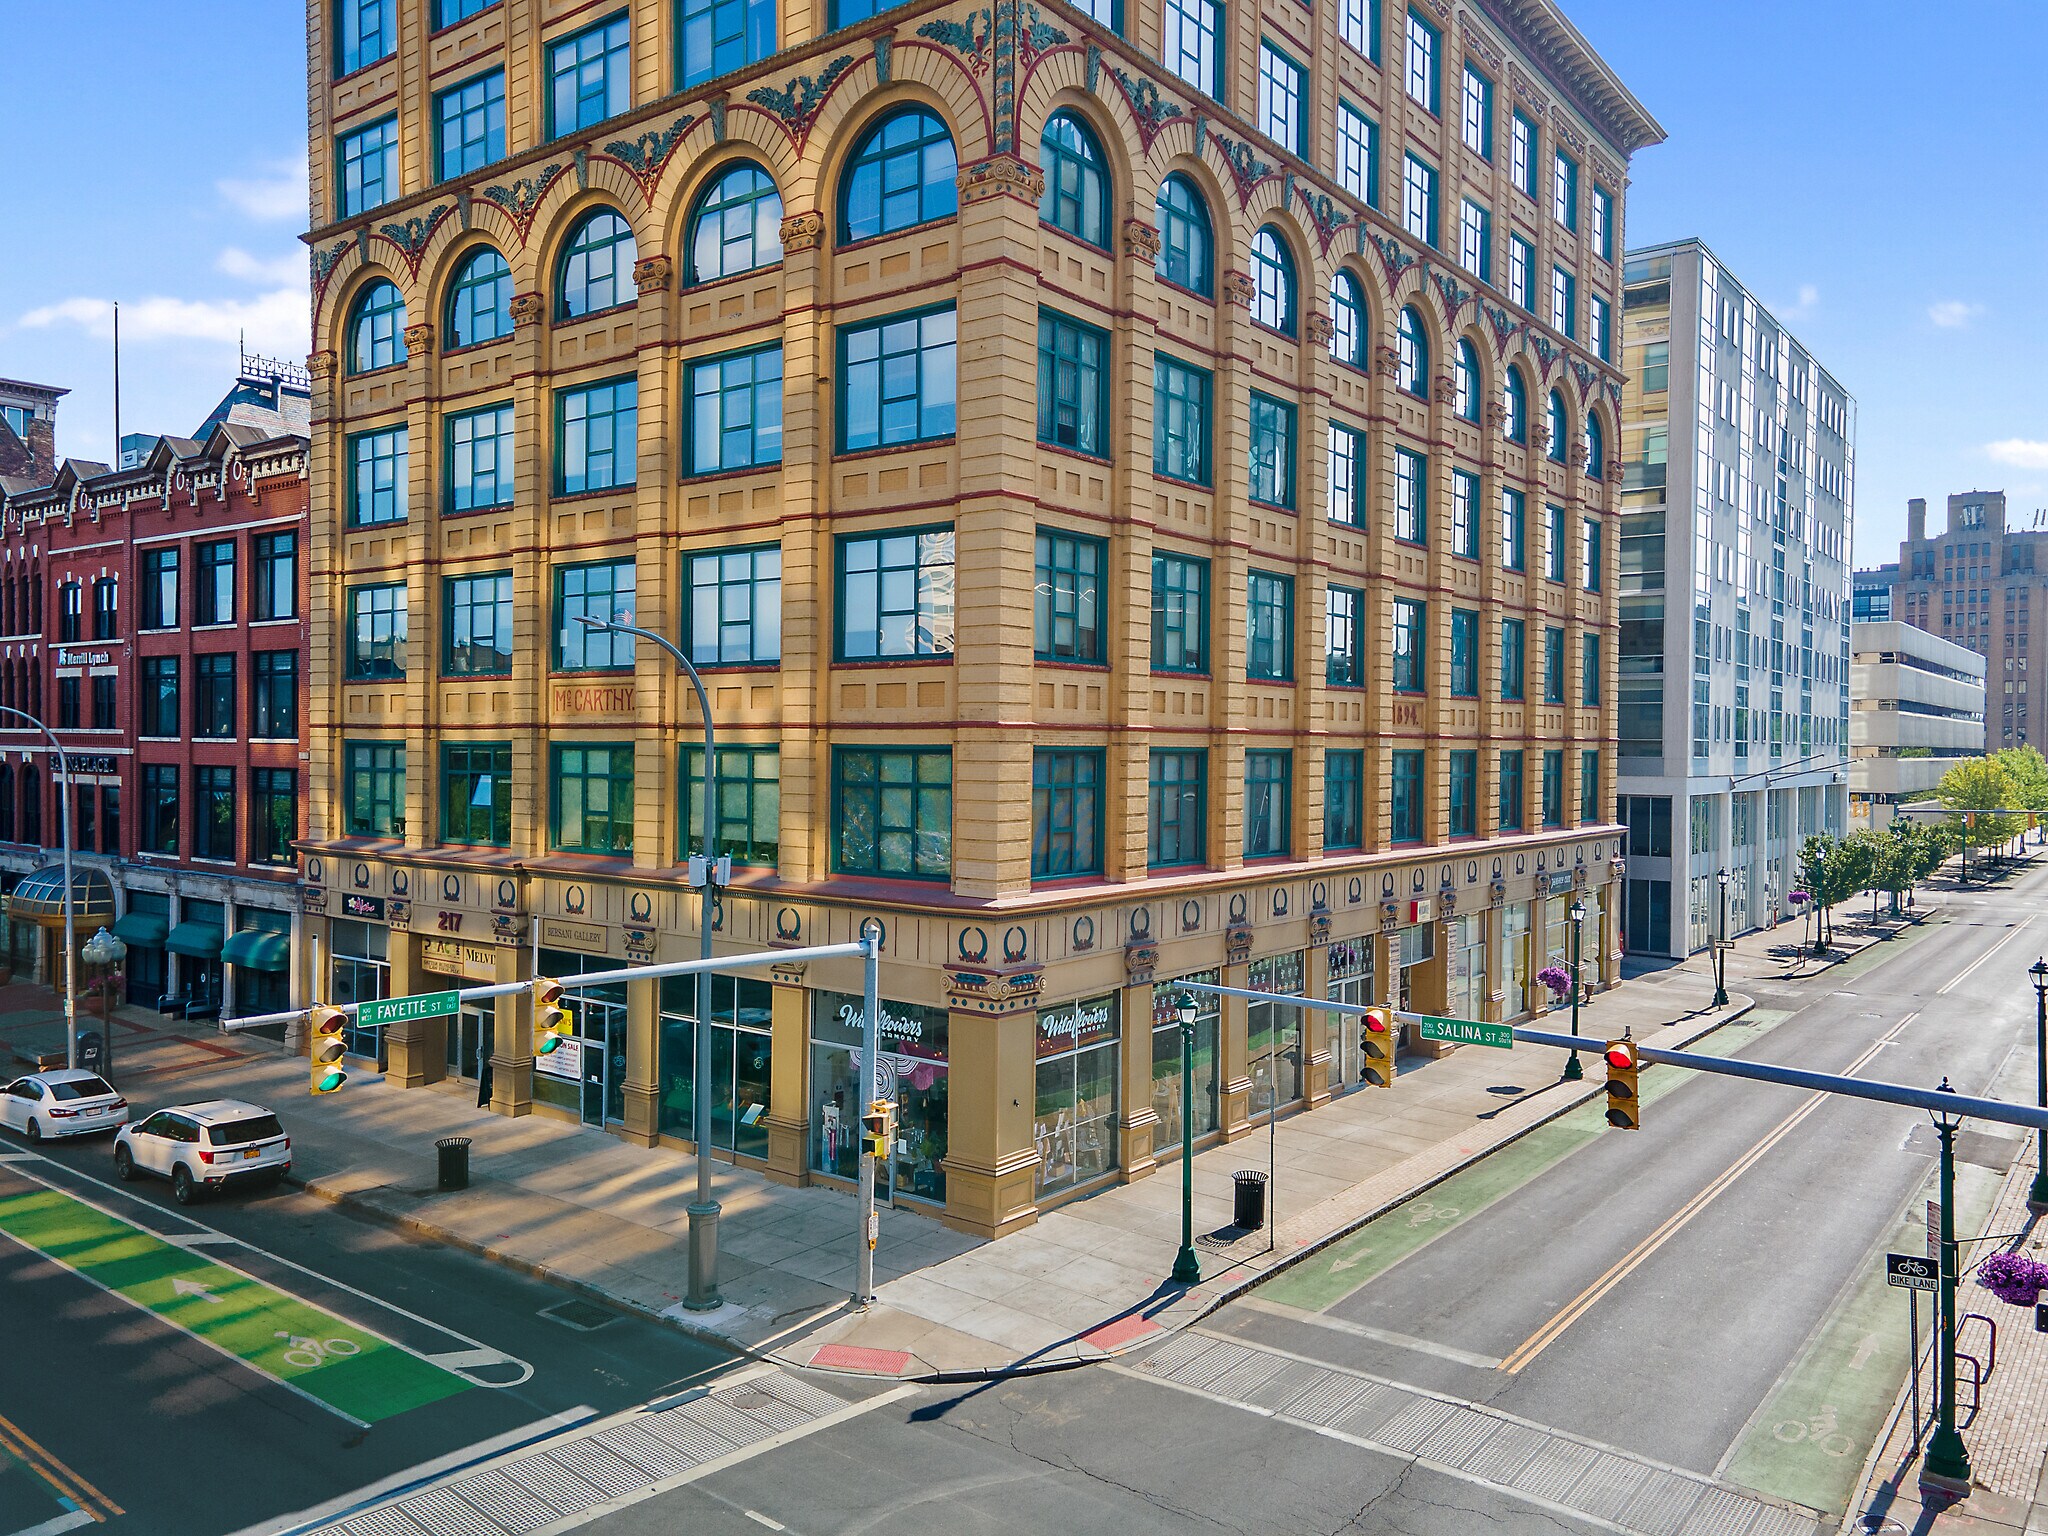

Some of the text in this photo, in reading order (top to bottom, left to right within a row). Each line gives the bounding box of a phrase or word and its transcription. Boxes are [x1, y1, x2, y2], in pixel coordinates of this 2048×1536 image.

[89, 651, 109, 666] Lynch
[50, 756, 79, 771] SANA
[437, 910, 463, 932] 217
[574, 930, 601, 943] GALLERY
[377, 1000, 441, 1019] FAYETTE ST
[840, 1004, 922, 1037] Wilowers
[1042, 1006, 1108, 1039] Wildflowers
[1078, 1023, 1106, 1034] ARMORY
[1437, 1022, 1496, 1042] SALINA ST
[1500, 1031, 1510, 1039] 300
[881, 1032, 919, 1042] ARMORY
[567, 1042, 579, 1051] SALE
[1890, 1275, 1937, 1290] BIKE LANE
